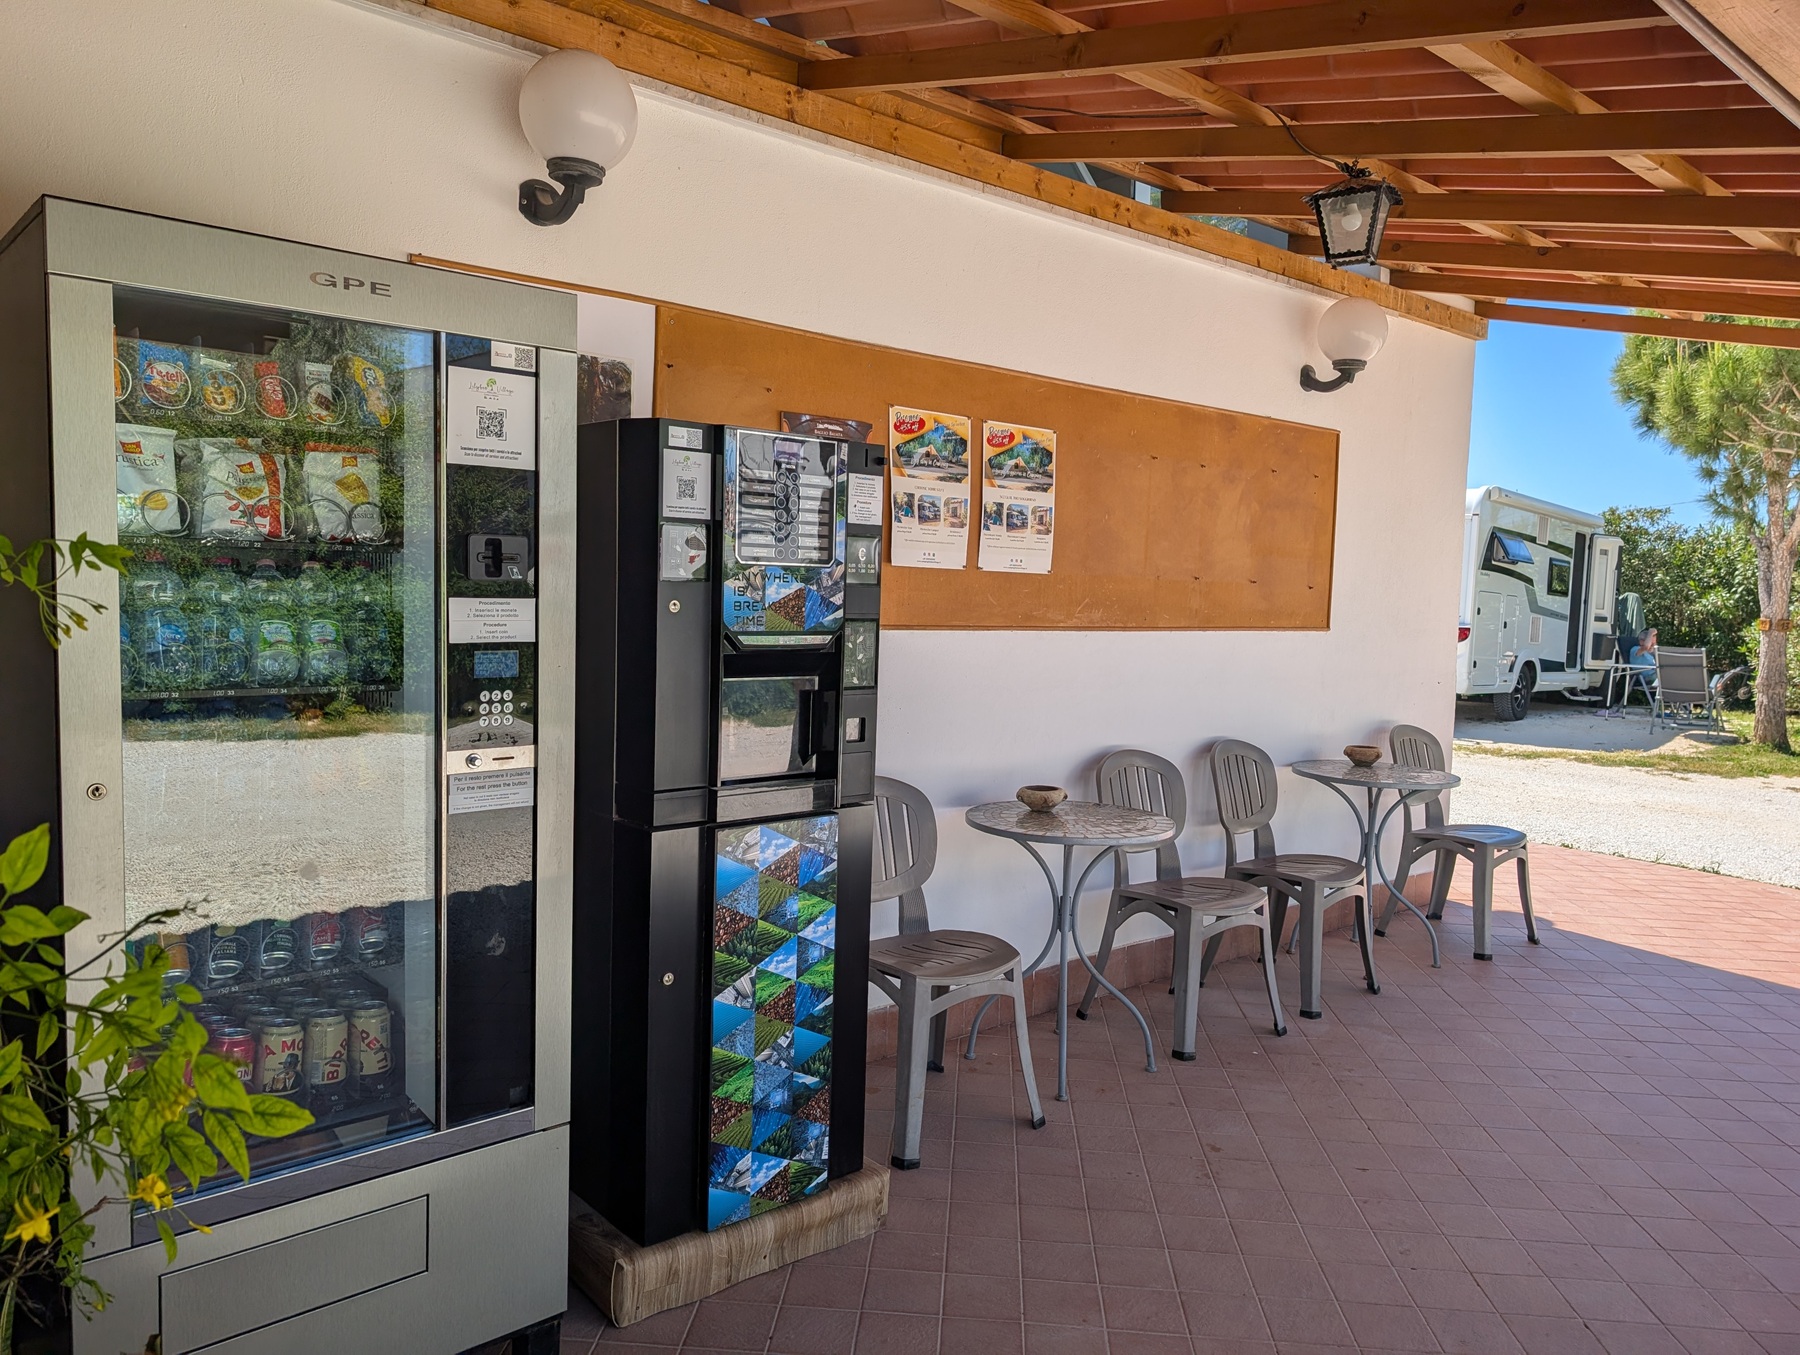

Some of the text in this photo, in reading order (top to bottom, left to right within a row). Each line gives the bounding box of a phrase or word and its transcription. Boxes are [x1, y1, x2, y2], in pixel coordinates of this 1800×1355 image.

[309, 271, 392, 298] GPE
[733, 570, 805, 584] ANYWHERE
[733, 586, 745, 597] IS
[733, 615, 765, 627] TIME
[482, 773, 504, 781] premere
[487, 783, 502, 791] press
